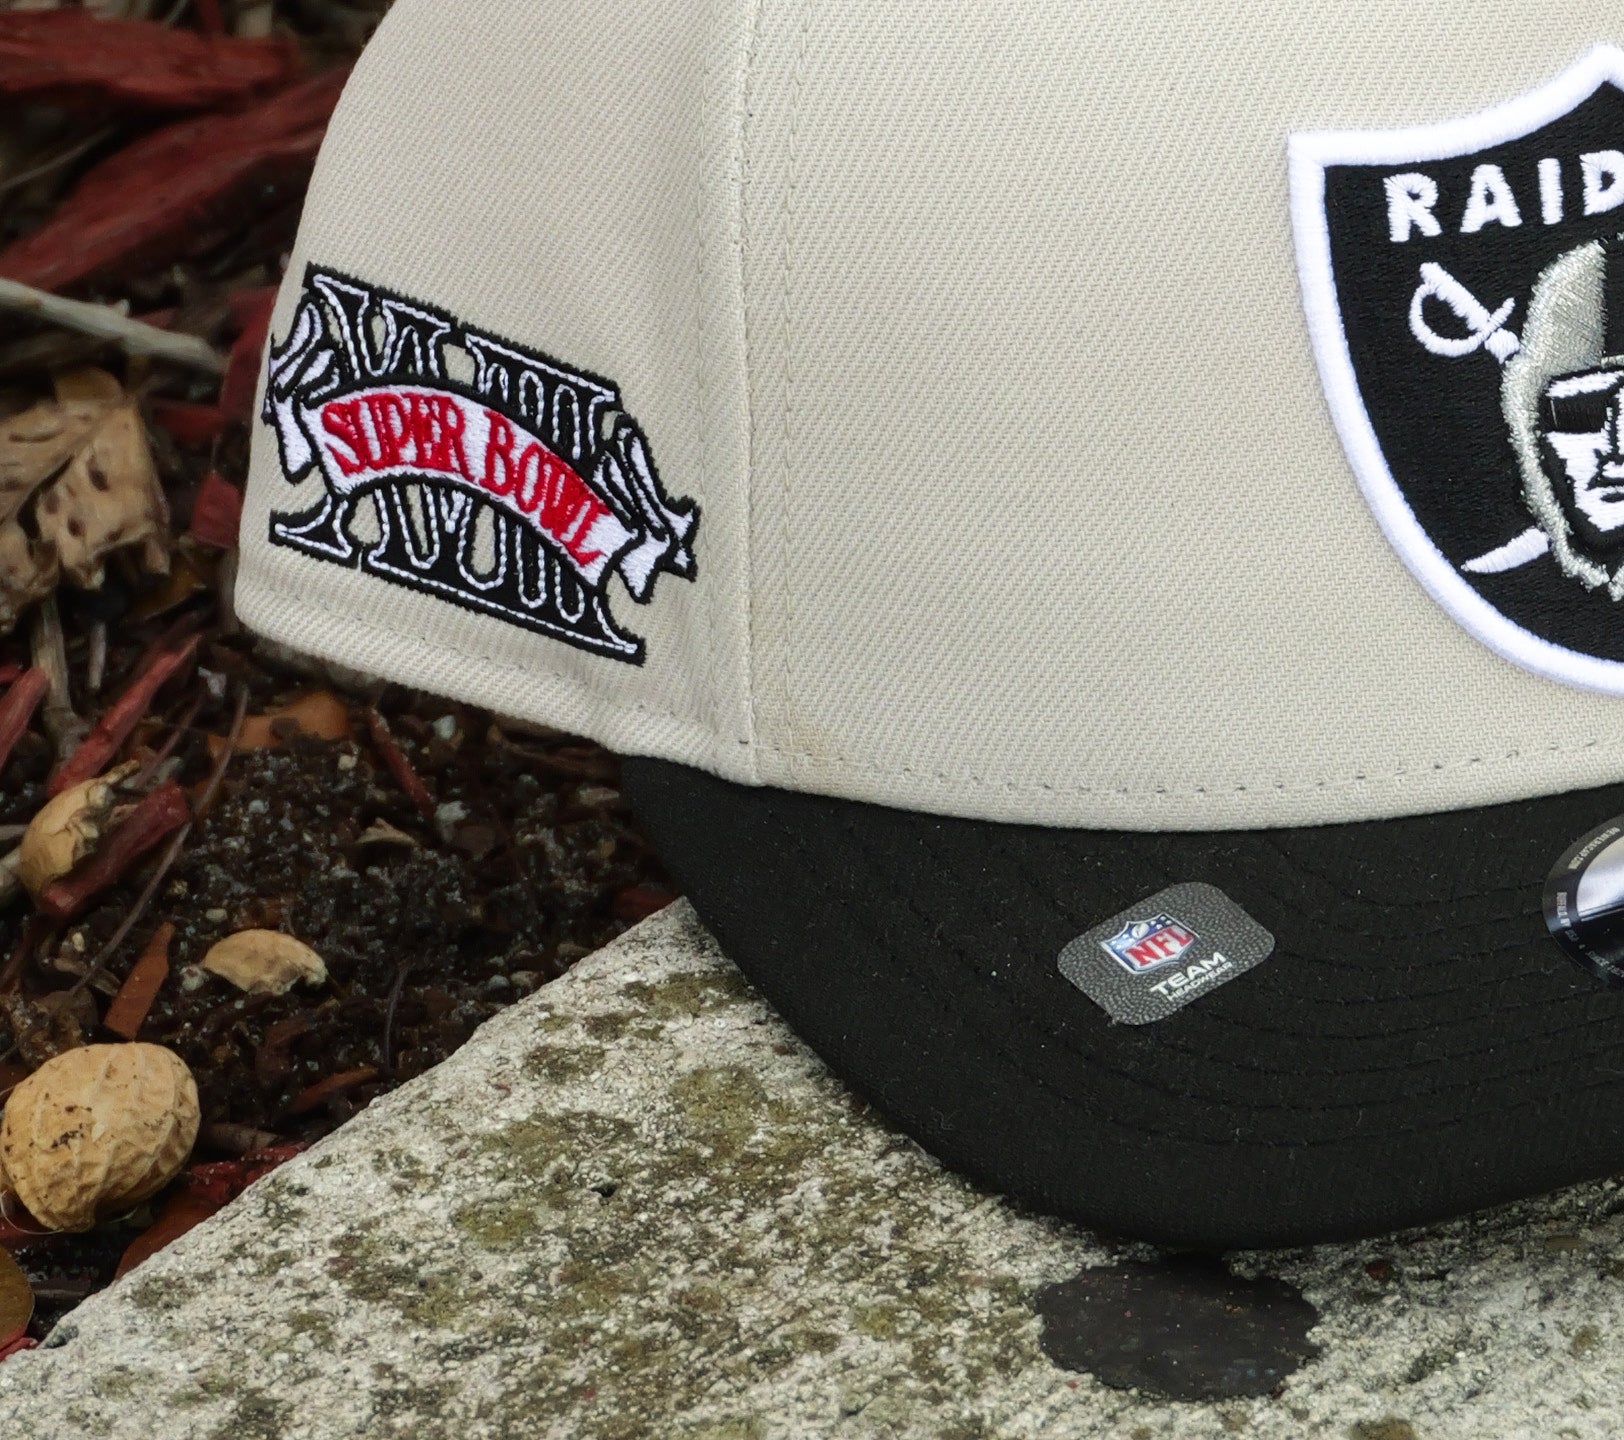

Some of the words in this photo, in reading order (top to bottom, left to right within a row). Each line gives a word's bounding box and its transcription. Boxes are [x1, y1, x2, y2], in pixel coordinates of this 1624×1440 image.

[321, 392, 476, 482] SUPER
[480, 408, 613, 567] BOWL
[1125, 926, 1195, 967] NFL
[1150, 952, 1227, 996] TEAM
[1167, 962, 1233, 1001] HEADWEAR
